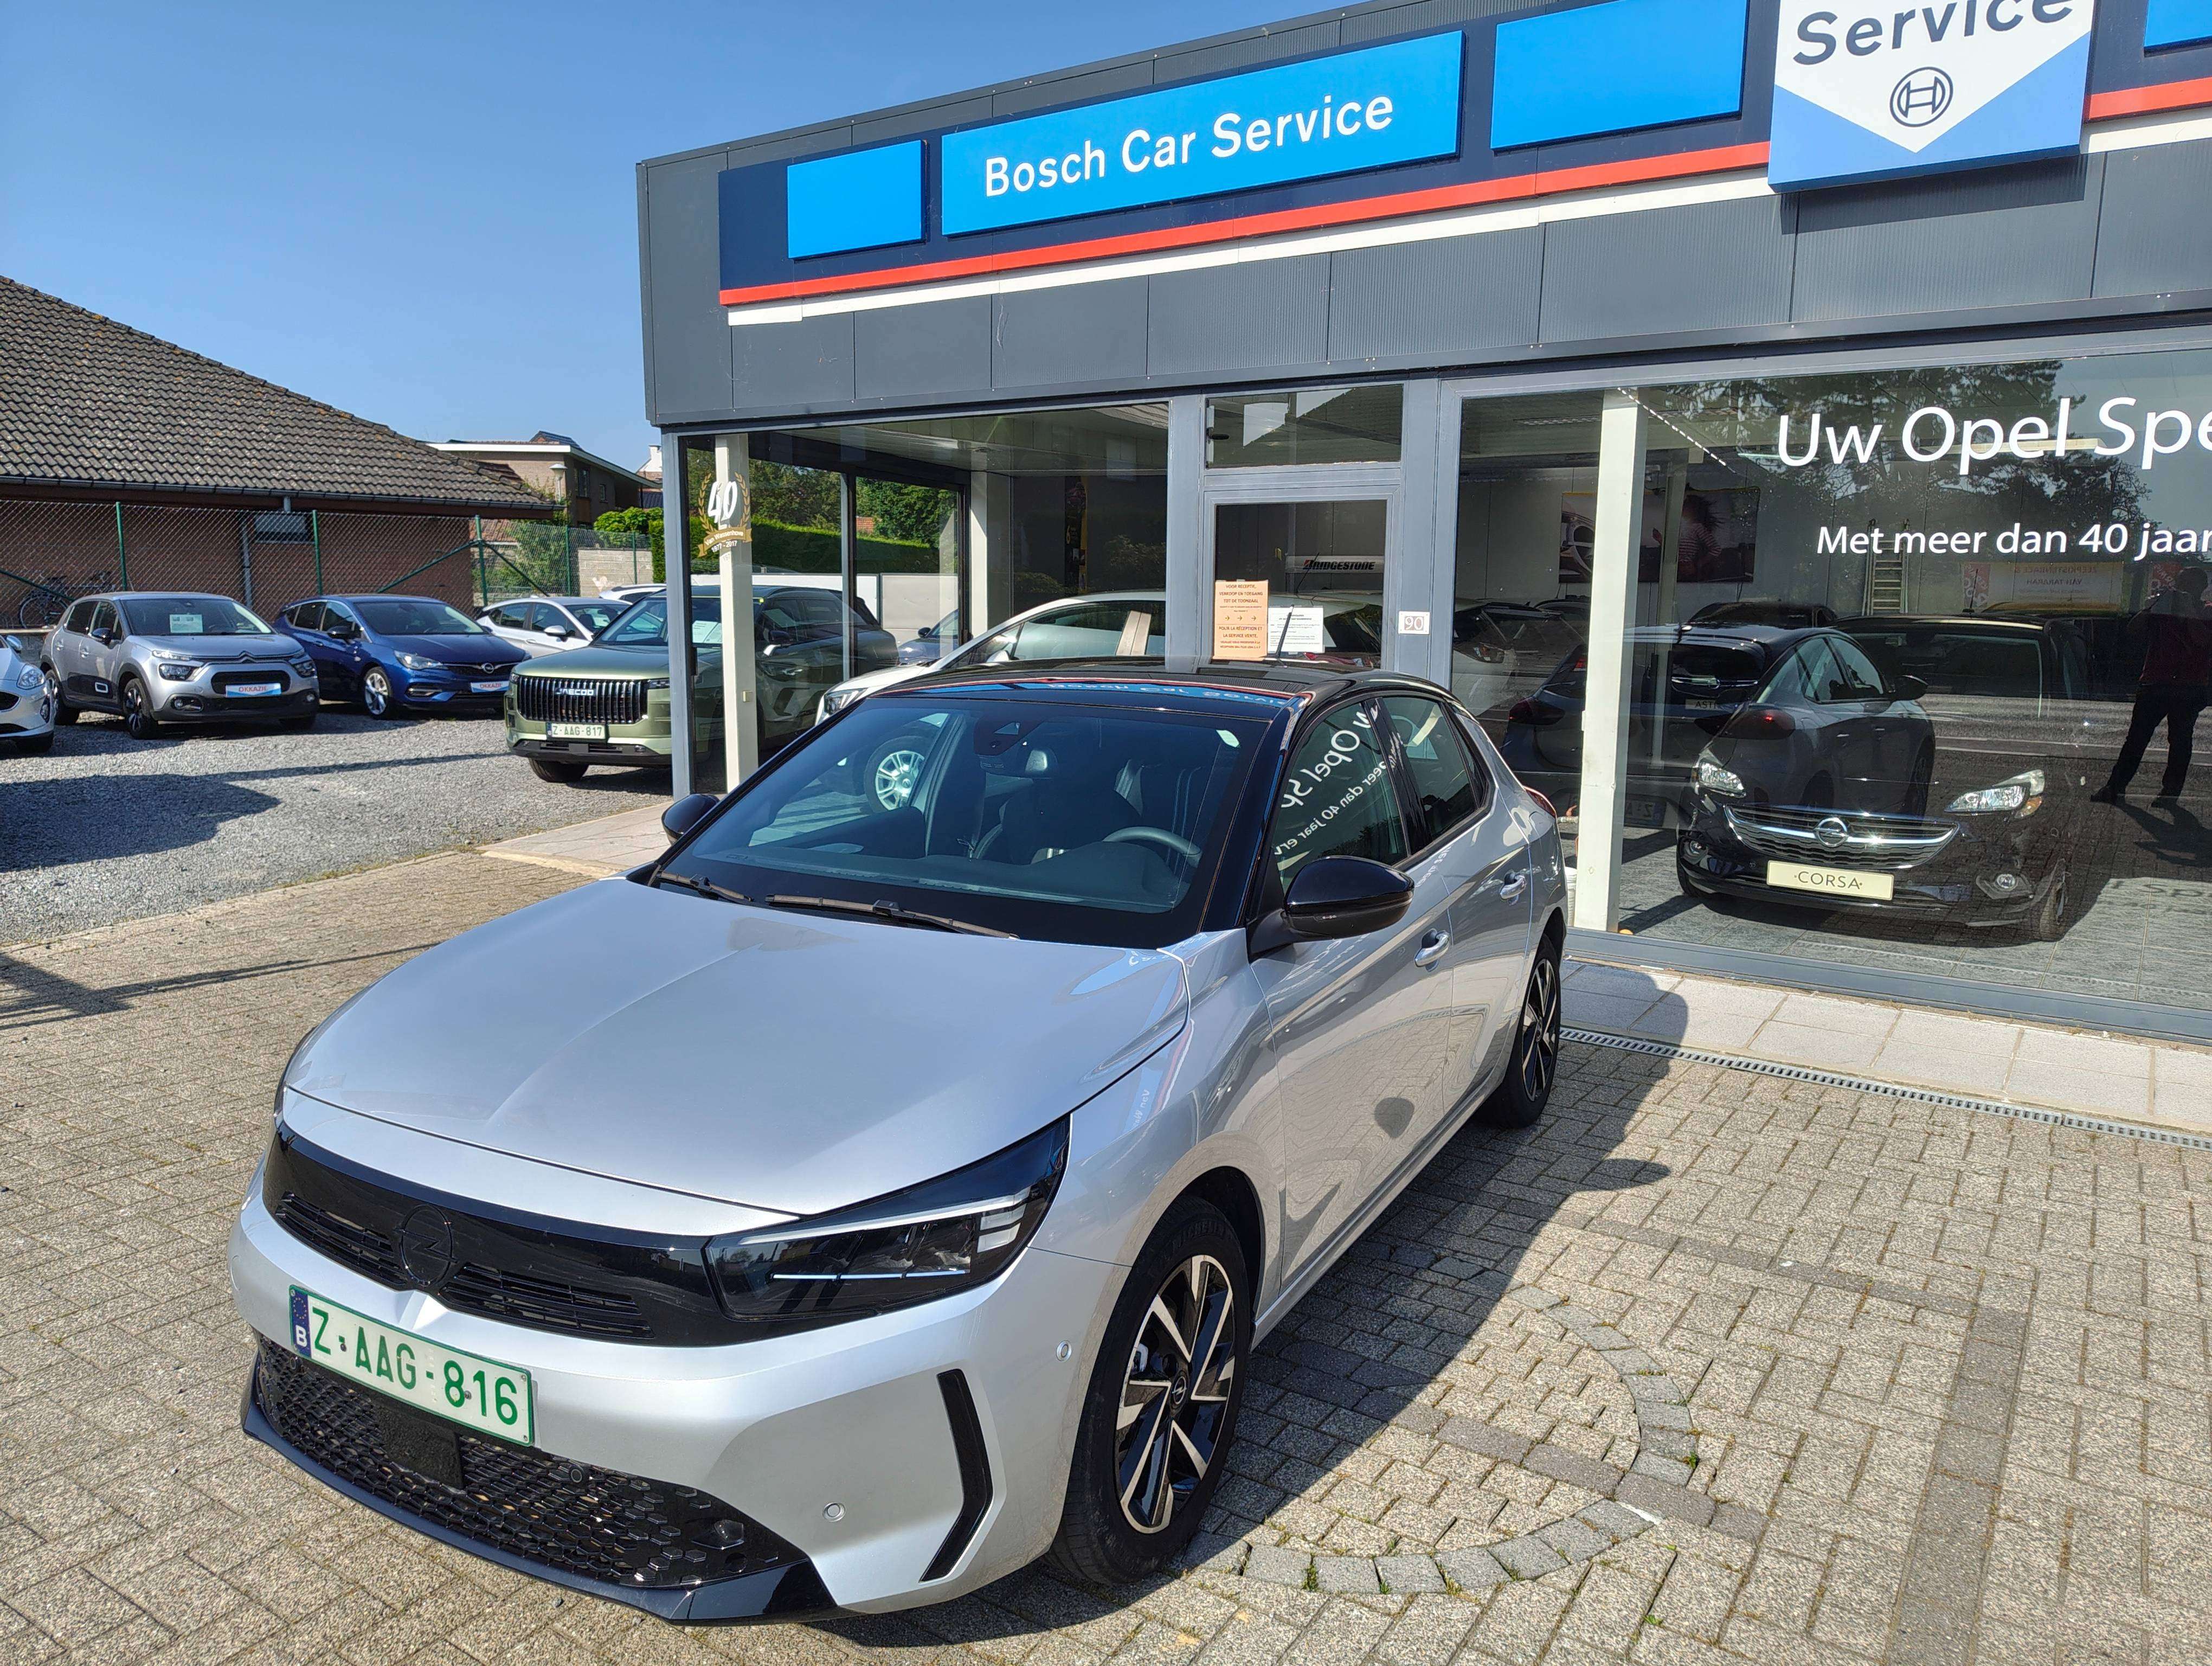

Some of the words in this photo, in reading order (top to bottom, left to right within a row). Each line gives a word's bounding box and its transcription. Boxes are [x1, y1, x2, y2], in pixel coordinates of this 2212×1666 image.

[1793, 0, 2073, 66] Service
[985, 140, 1105, 197] Bosch
[1122, 129, 1197, 173] Car
[1211, 94, 1394, 158] Service
[1778, 412, 1882, 467] Uw
[1902, 397, 2071, 475] Opel
[708, 481, 738, 523] 40
[704, 537, 715, 546] Van
[713, 530, 744, 541] Wassenhove
[725, 540, 738, 548] 2017
[1817, 526, 1884, 554] Met
[1894, 531, 1988, 554] meer
[1996, 523, 2067, 554] dan
[2079, 523, 2129, 553] 40
[2134, 522, 2212, 561] jaar
[1302, 559, 1375, 571] BRIDGESTONE
[1404, 616, 1424, 630] 90
[295, 1324, 308, 1348] B
